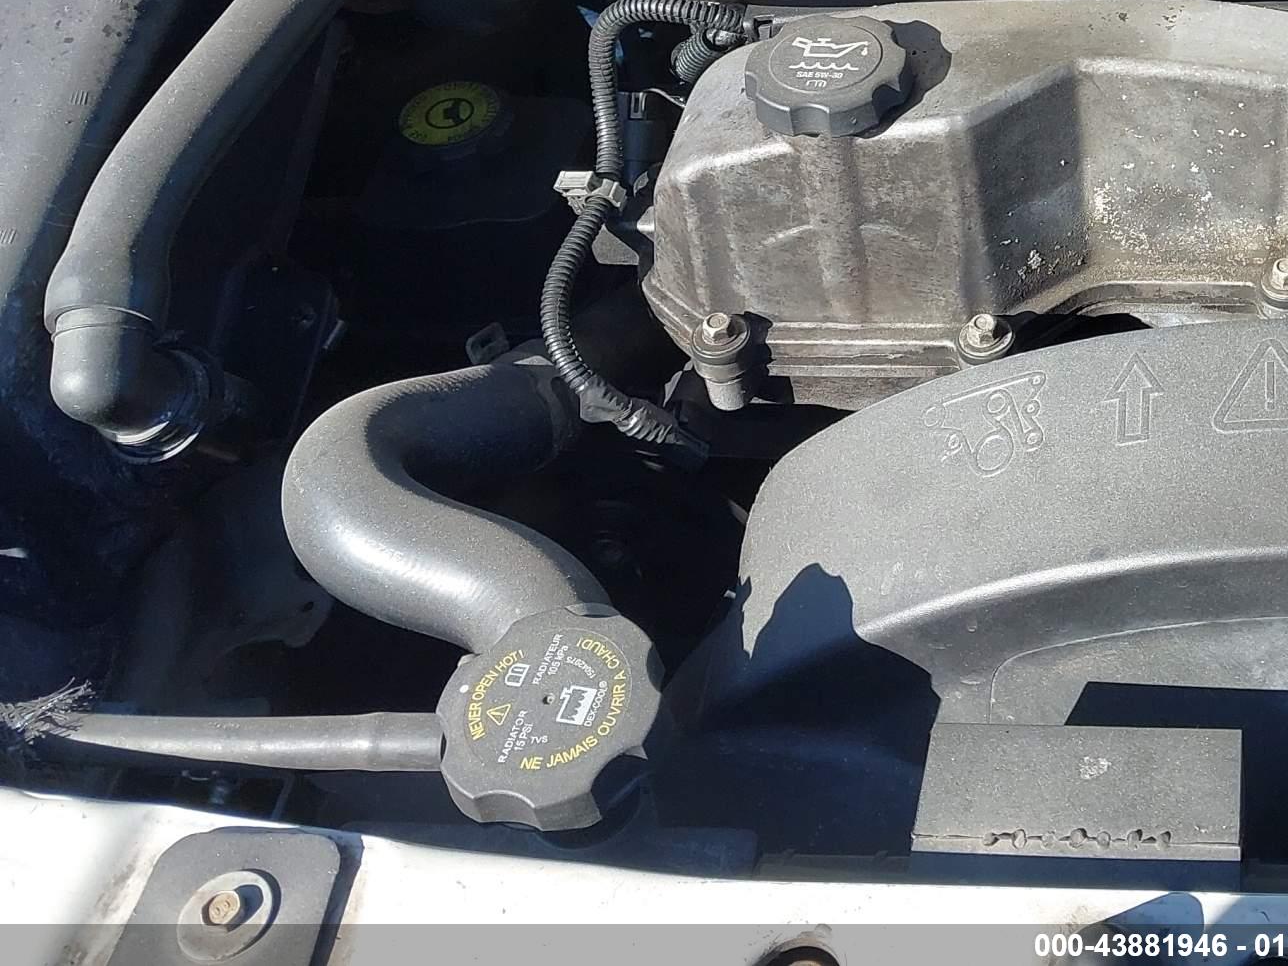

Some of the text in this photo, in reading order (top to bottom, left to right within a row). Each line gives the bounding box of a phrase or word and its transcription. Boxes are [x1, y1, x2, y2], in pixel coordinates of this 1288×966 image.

[814, 71, 844, 79] 5W-30
[532, 634, 564, 686] RADIATEUR
[547, 645, 569, 676] 105 kPa
[576, 637, 620, 670] CHAUD!
[468, 649, 525, 741] NEVER OPEN HOT!
[597, 683, 626, 736] OUVRIR
[498, 710, 529, 763] RADIATOR
[514, 740, 526, 751] 15
[530, 735, 549, 744] TVS
[546, 735, 599, 768] JAMAIS
[520, 756, 544, 770] NE
